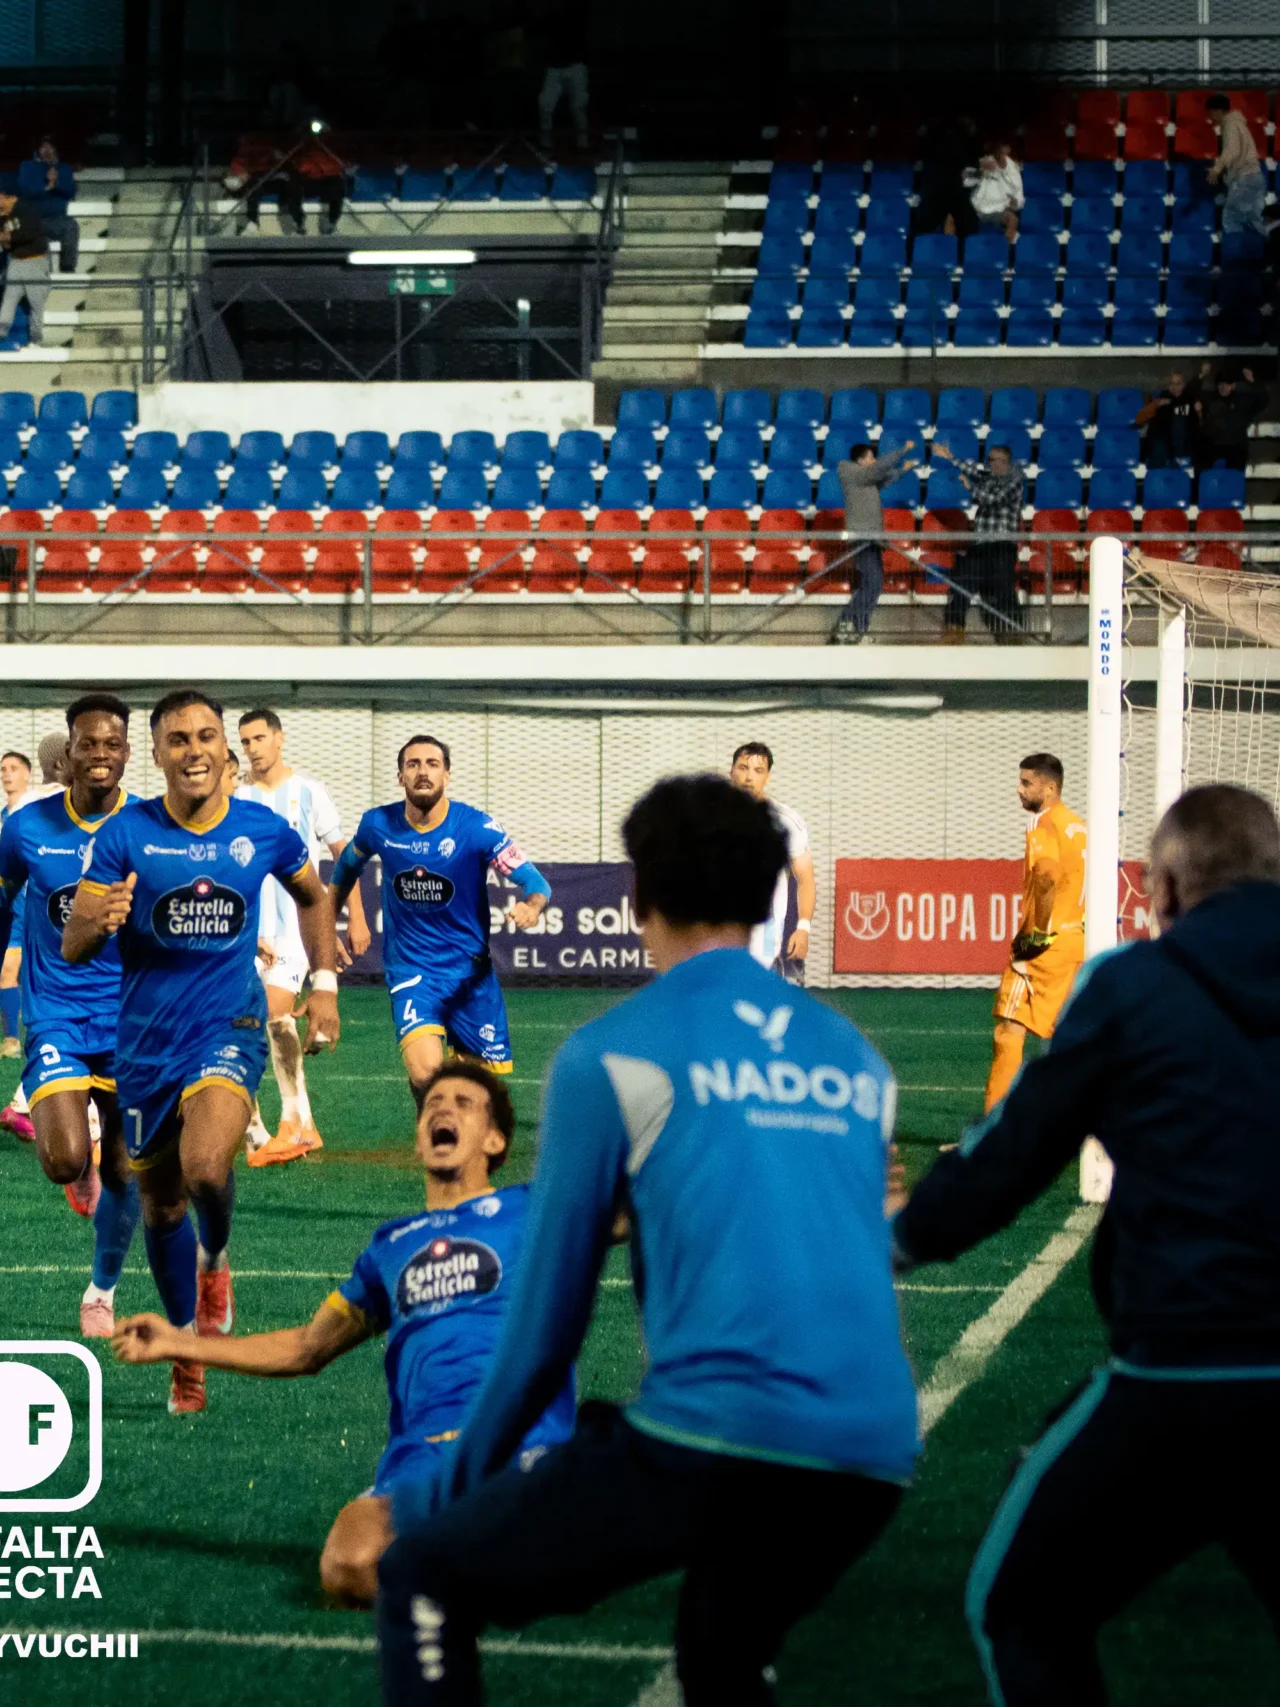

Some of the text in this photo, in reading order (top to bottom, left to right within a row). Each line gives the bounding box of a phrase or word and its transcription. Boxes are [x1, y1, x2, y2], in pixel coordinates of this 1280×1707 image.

[1099, 619, 1111, 675] MONDO
[400, 876, 443, 891] Estrella
[402, 887, 442, 901] Galicia
[168, 898, 234, 916] Estrella
[897, 893, 977, 941] COPA
[169, 915, 229, 935] Galicia
[514, 948, 546, 969] EL
[403, 999, 420, 1022] 4
